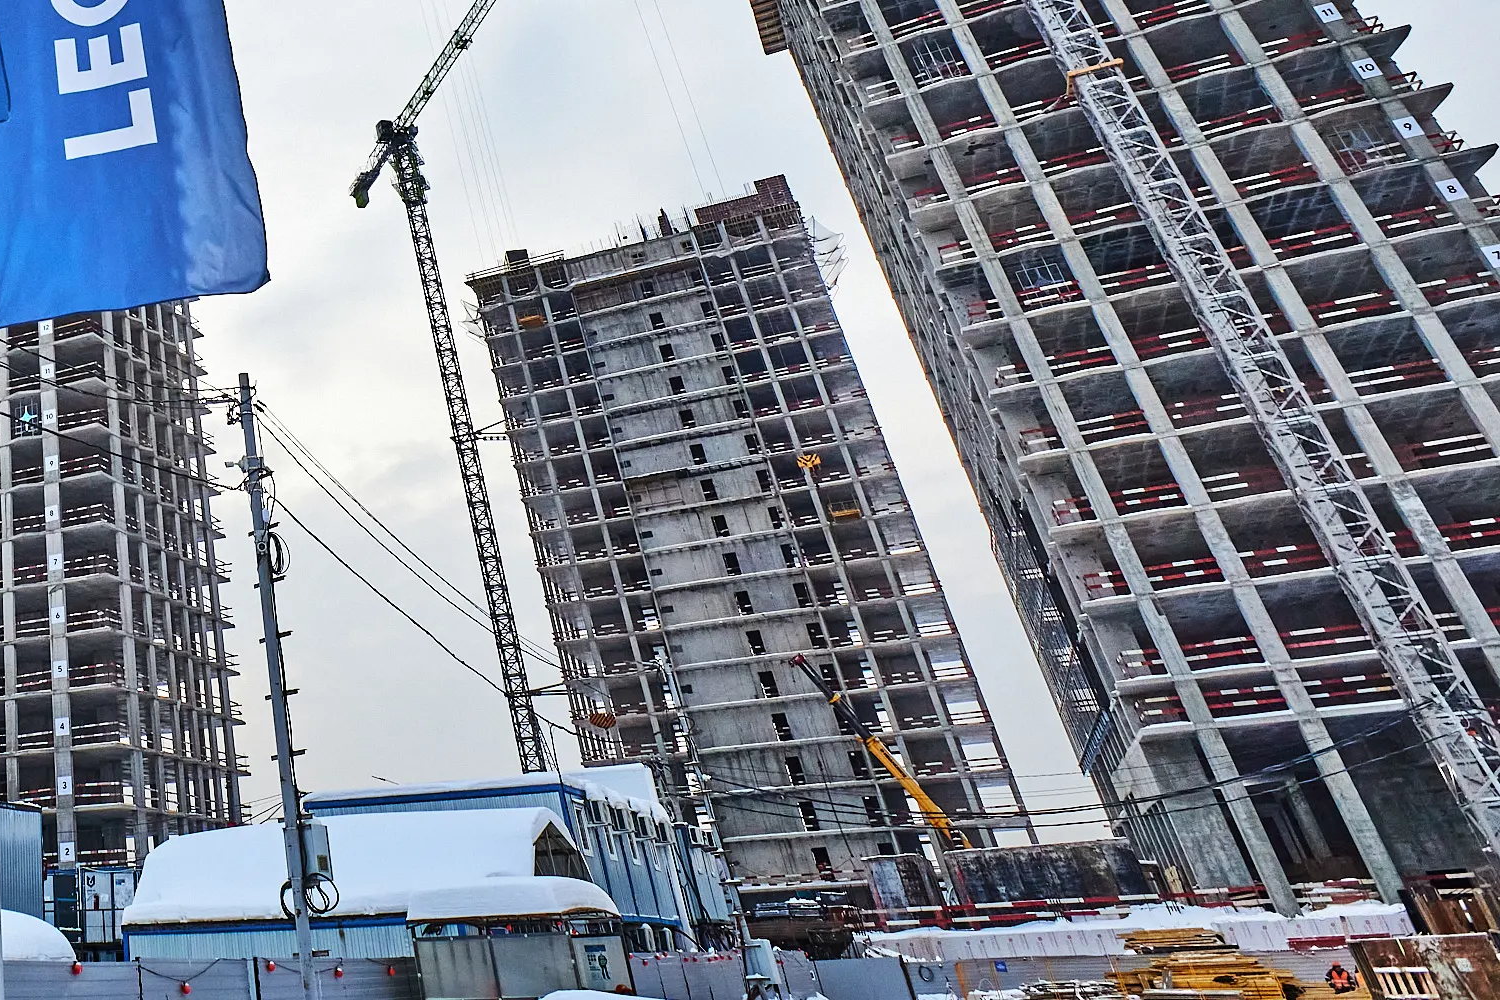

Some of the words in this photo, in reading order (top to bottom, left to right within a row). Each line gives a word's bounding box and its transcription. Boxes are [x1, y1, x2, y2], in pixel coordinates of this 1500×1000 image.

[1321, 8, 1335, 17] 11
[1358, 63, 1375, 73] 10
[1403, 122, 1412, 132] 9
[1446, 184, 1457, 194] 8
[53, 558, 58, 566] 7
[57, 665, 62, 673] 5
[60, 722, 65, 731] 4
[62, 781, 67, 790] 3
[65, 848, 70, 856] 2
